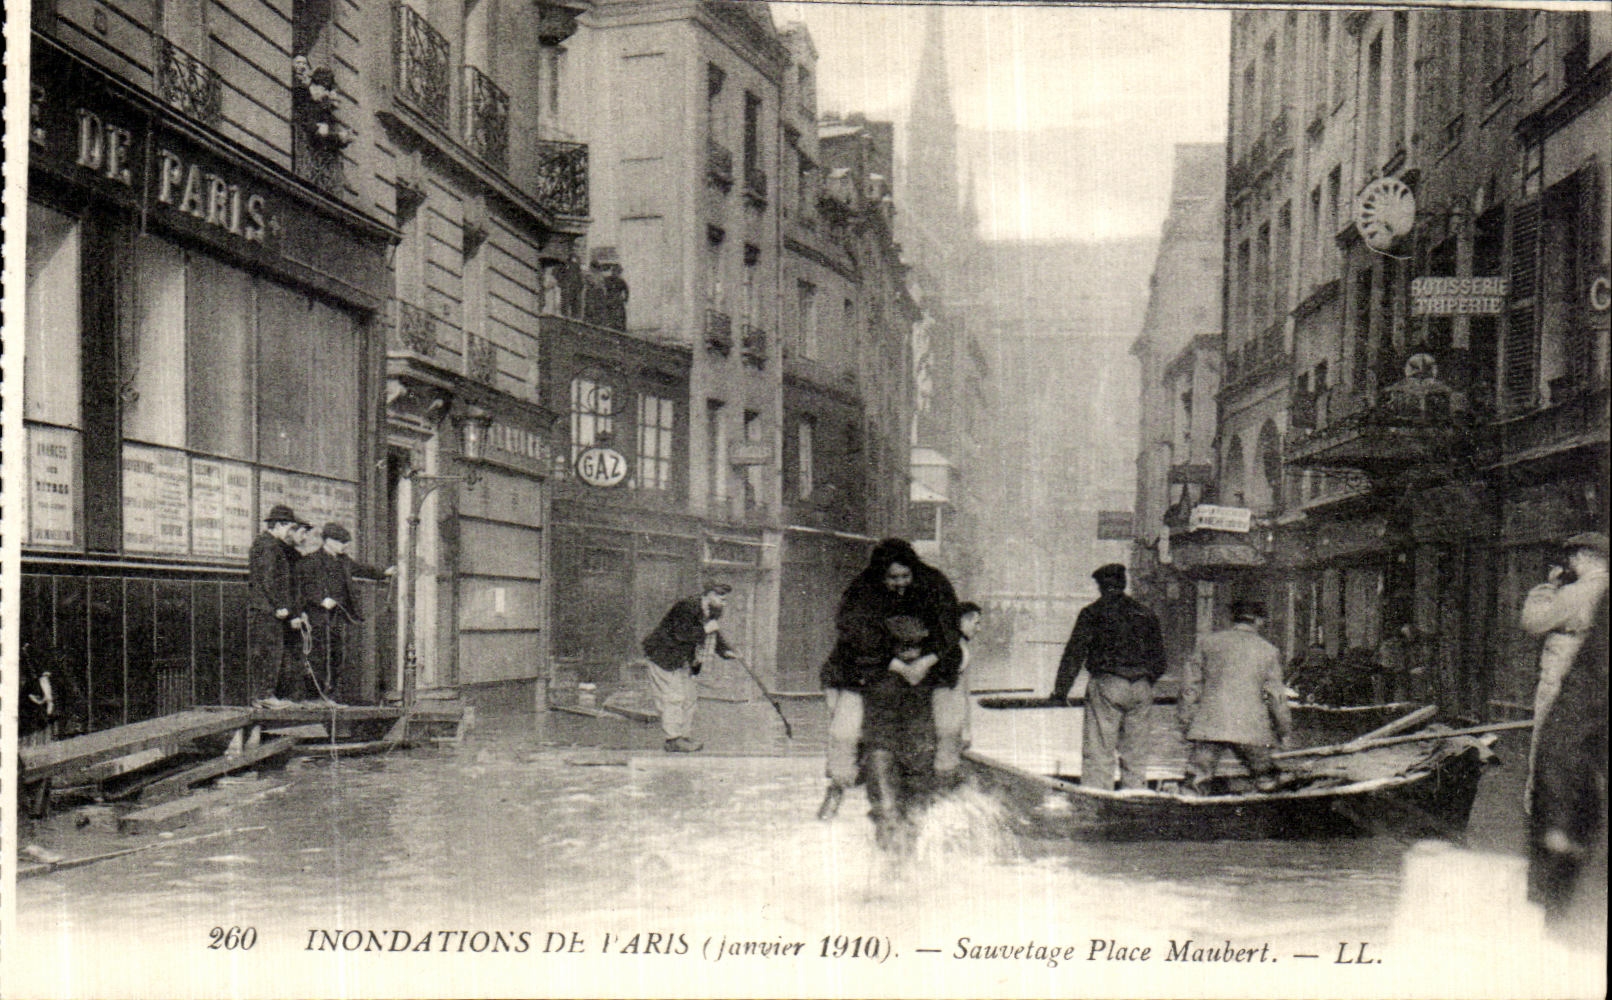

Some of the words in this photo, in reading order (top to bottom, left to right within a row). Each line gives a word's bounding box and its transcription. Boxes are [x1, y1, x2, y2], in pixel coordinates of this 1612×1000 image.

[78, 107, 131, 186] DE
[158, 149, 265, 243] PARIS
[583, 452, 621, 480] GAZ
